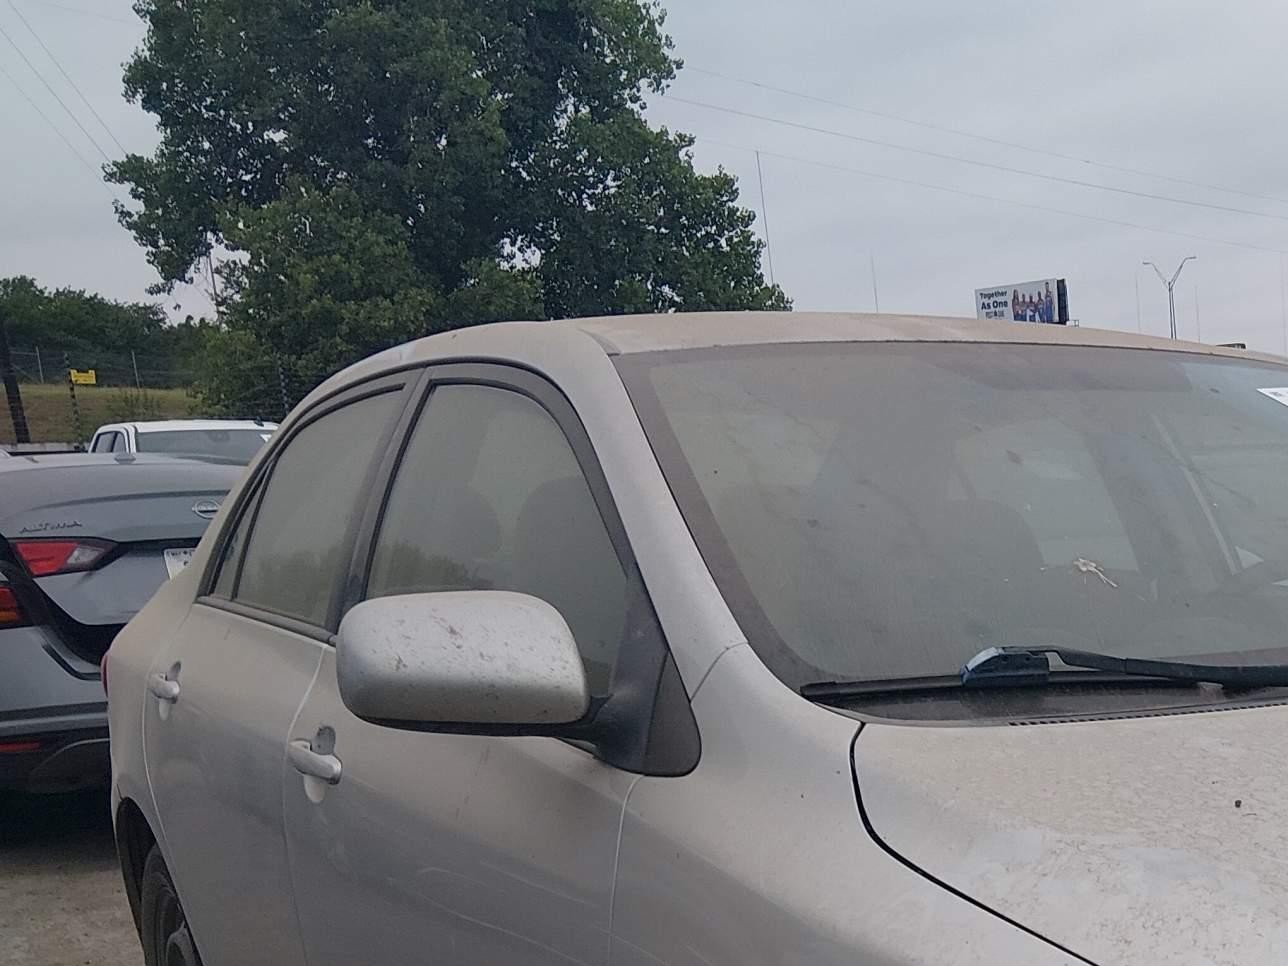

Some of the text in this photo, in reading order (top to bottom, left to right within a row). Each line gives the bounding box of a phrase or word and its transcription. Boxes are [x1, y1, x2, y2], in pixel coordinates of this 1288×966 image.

[979, 290, 1007, 300] Together
[981, 300, 1008, 310] As One
